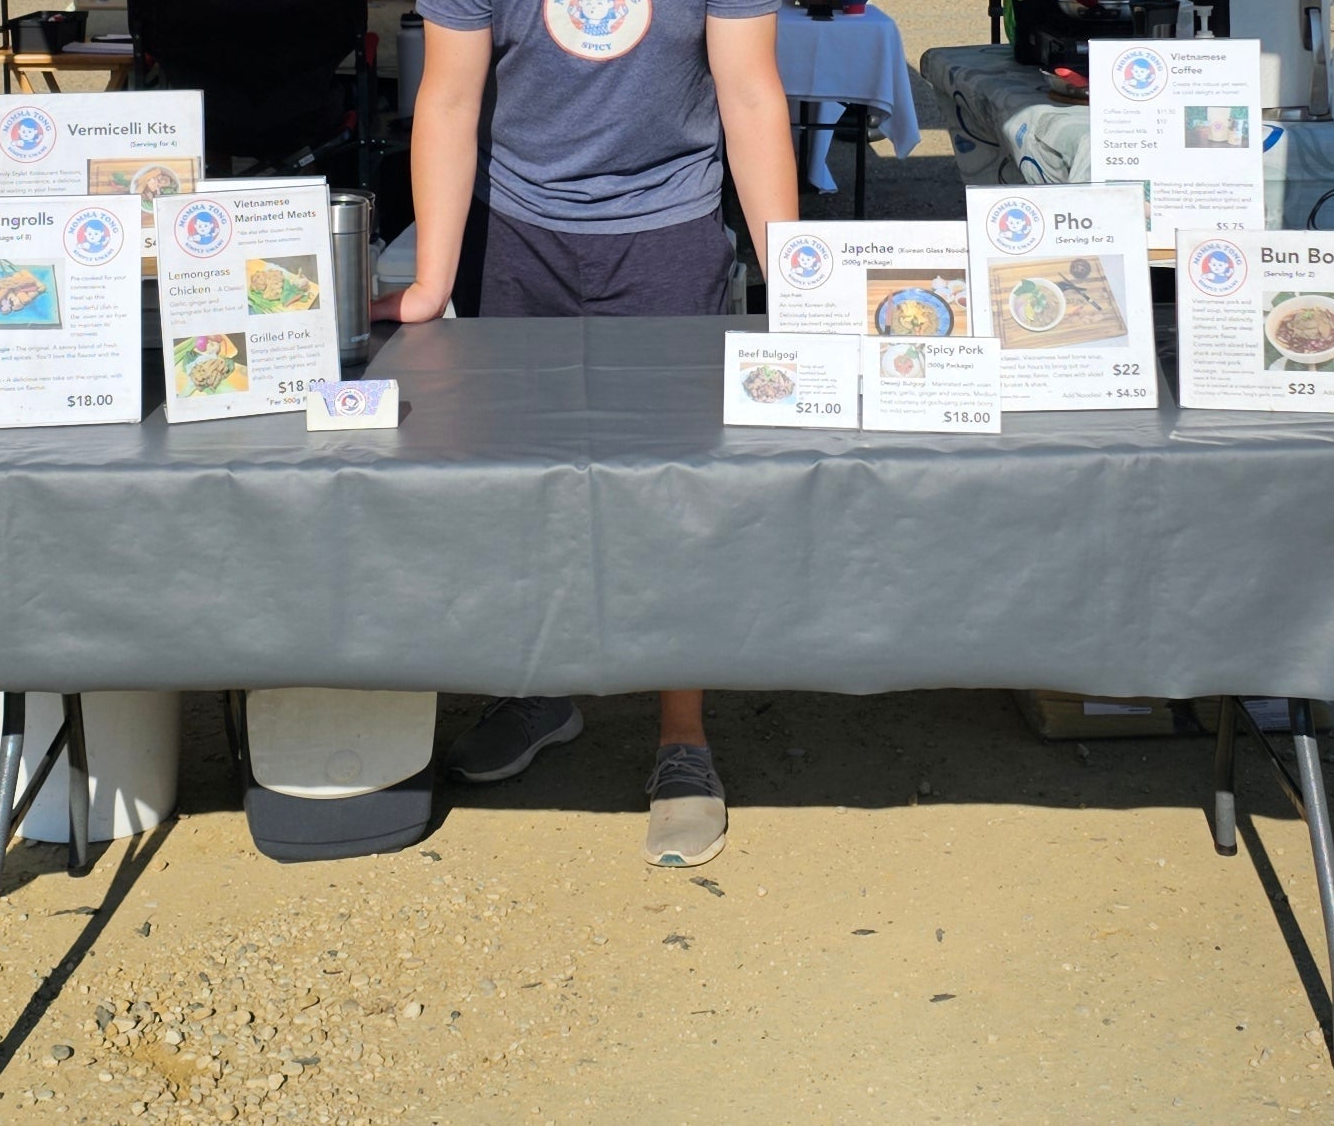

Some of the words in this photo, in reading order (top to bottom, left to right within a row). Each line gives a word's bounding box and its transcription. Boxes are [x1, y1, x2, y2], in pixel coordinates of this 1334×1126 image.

[581, 41, 612, 51] SPICY
[1117, 51, 1143, 72] MOMMA
[1170, 53, 1227, 61] Vietnamese
[1170, 66, 1203, 75] Coffee
[3, 110, 31, 133] MOMMA
[33, 111, 52, 133] TONG
[67, 122, 141, 136] Vermicelli
[147, 122, 177, 135] Kits
[1103, 139, 1138, 149] Starter
[1140, 140, 1158, 149] Set
[1105, 156, 1140, 166] $25.00
[234, 198, 290, 209] Vietnamese
[179, 204, 206, 228] MOMMA
[208, 204, 227, 225] TONG
[235, 211, 284, 223] Marinated
[287, 210, 317, 219] Meats
[990, 201, 1018, 223] MOMMA
[1020, 202, 1040, 223] TONG
[68, 211, 98, 235] MOMMA
[100, 212, 119, 234] TONG
[1054, 212, 1093, 230] Pho
[1055, 236, 1089, 245] (Serving
[784, 239, 810, 260] MOMMA
[811, 239, 829, 260] TONG
[841, 242, 894, 256] Japchae
[1193, 243, 1221, 265] MOMMA
[1224, 244, 1242, 265] TONG
[1261, 247, 1300, 264] Bun
[1308, 248, 1334, 264] Bo
[168, 268, 231, 281] Lemongrass
[169, 286, 211, 297] Chicken
[250, 331, 285, 343] Grilled
[287, 329, 311, 340] Pork
[738, 349, 760, 358] Beef
[762, 350, 798, 360] Bulgogi
[927, 345, 955, 356] Spicy
[958, 345, 984, 354] Pork
[1113, 363, 1140, 376] $22
[1116, 388, 1147, 398] $4.50
[1288, 383, 1316, 395] $23
[67, 394, 113, 407] $18.00
[796, 402, 842, 415] $21.00
[943, 411, 991, 424] $18.00
